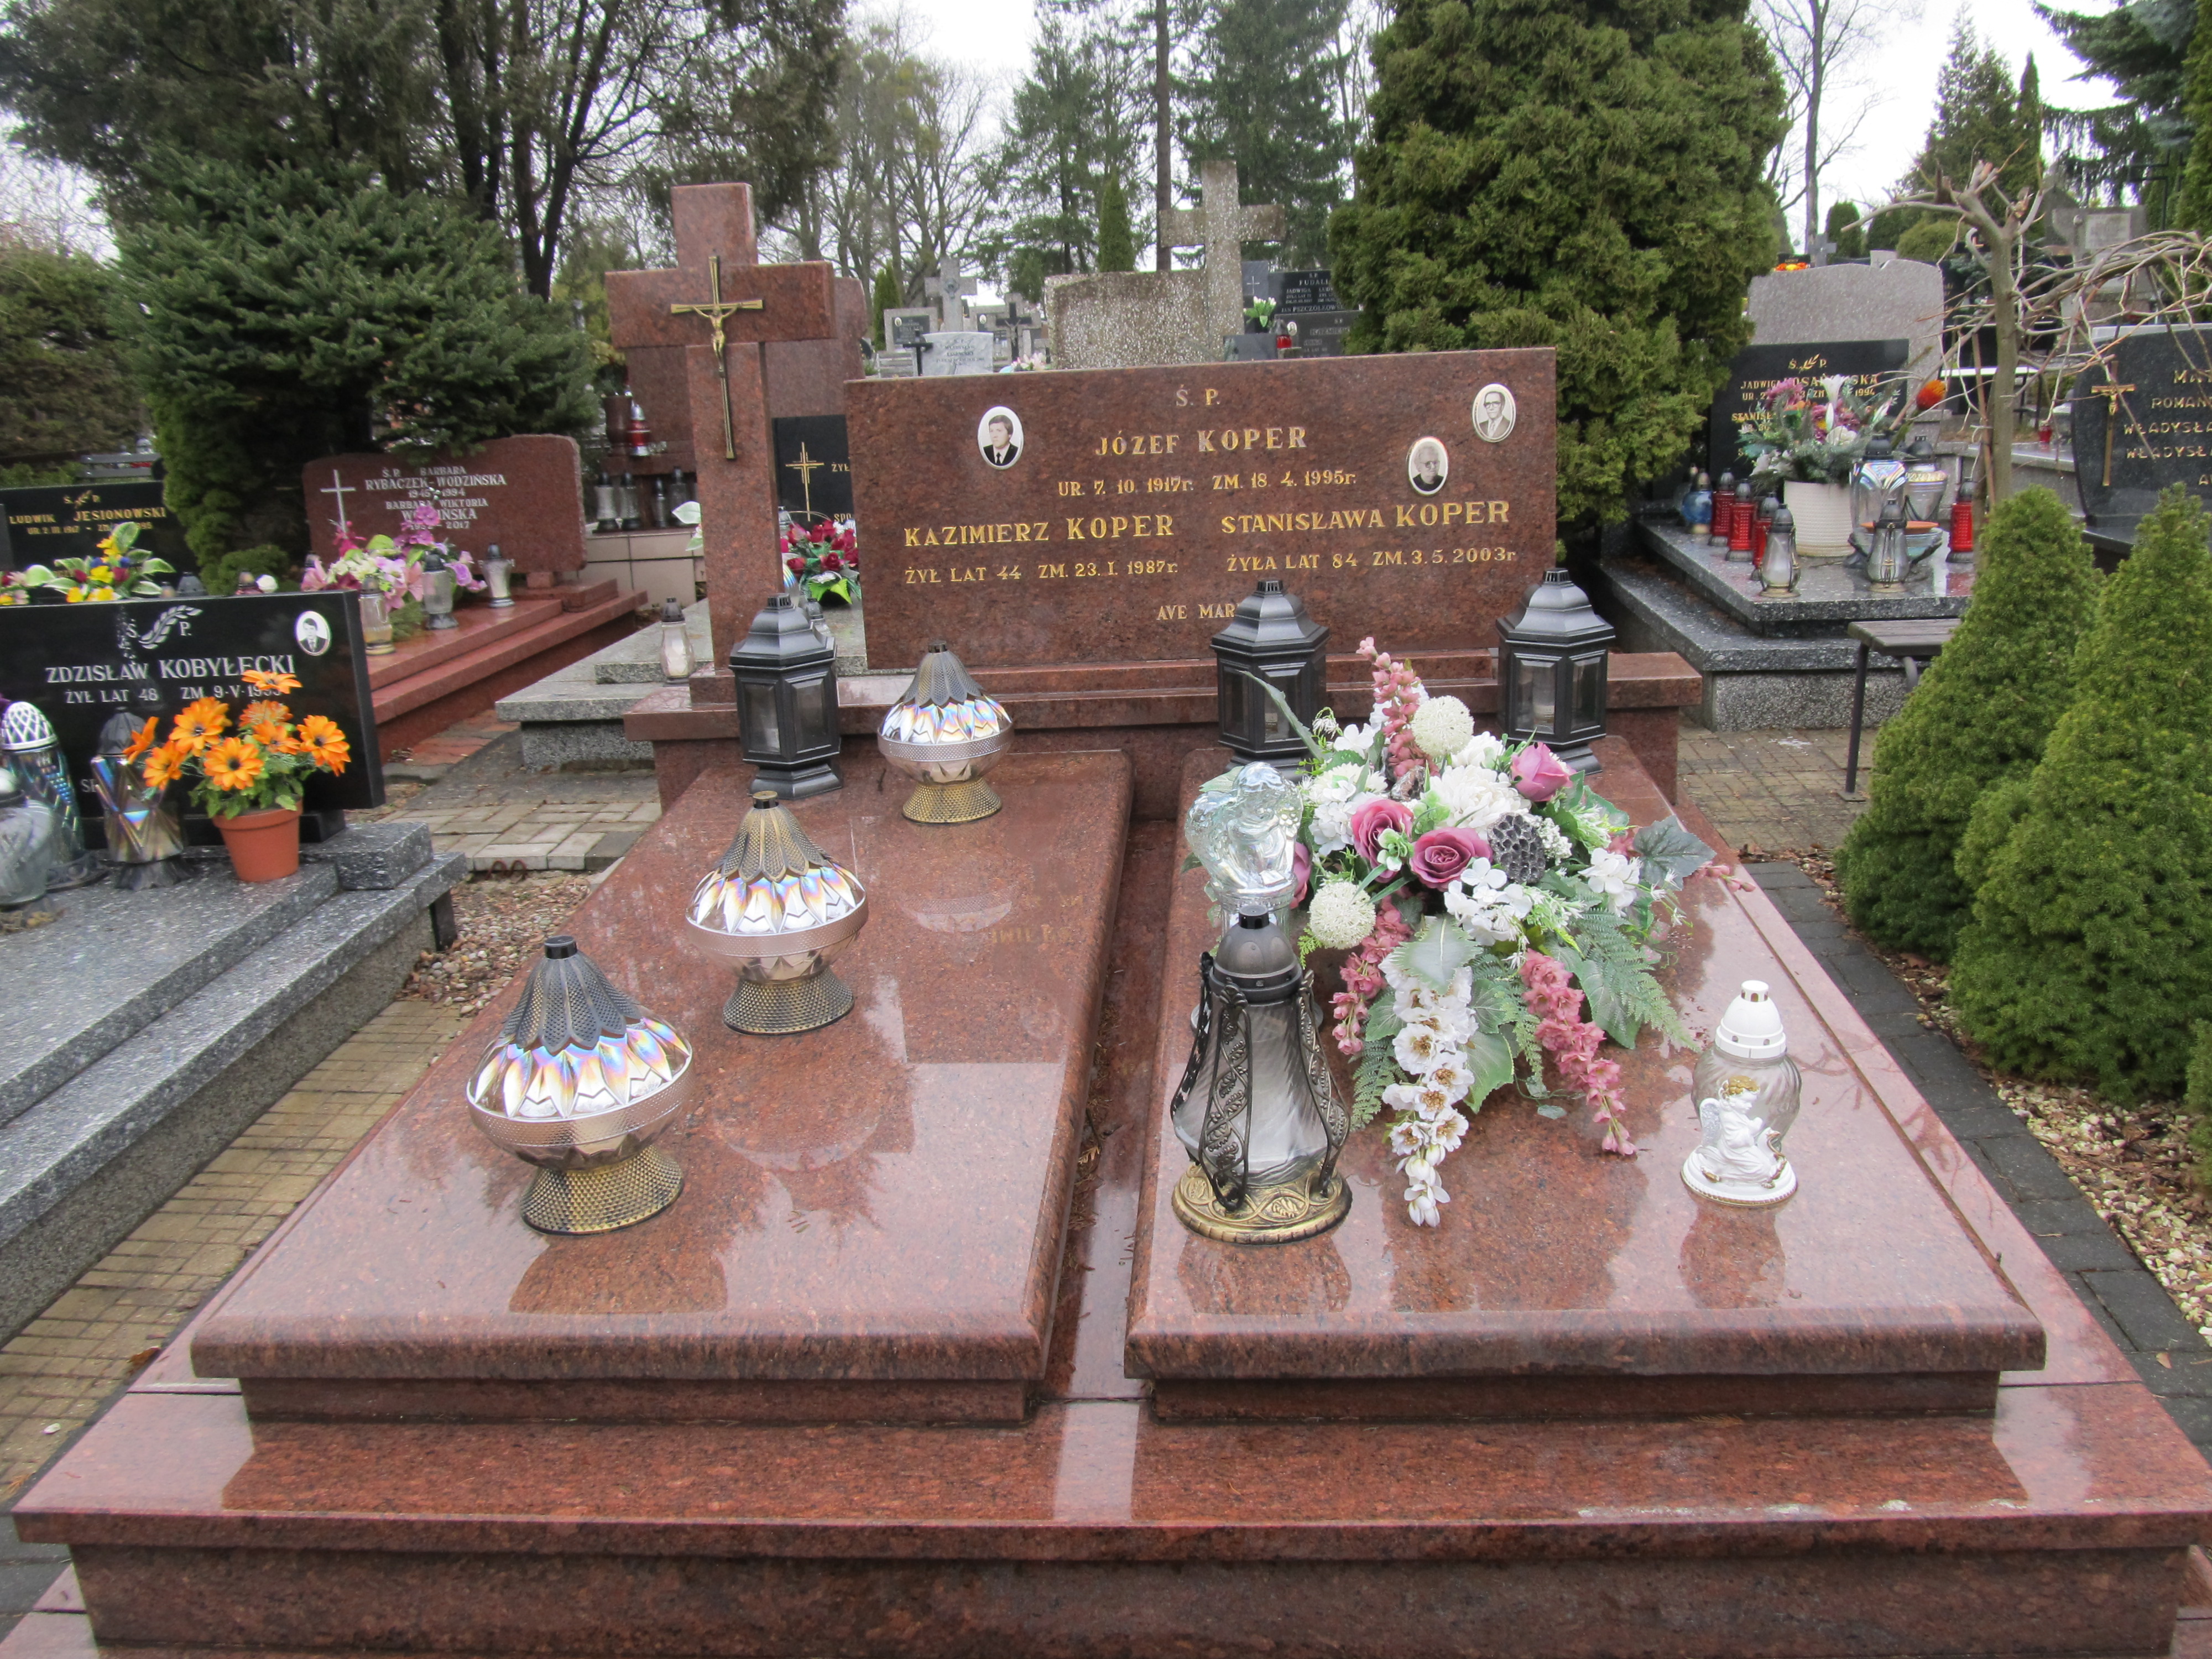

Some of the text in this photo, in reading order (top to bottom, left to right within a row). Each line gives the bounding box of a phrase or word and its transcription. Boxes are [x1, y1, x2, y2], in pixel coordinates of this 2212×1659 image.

[1205, 388, 1220, 405] P.
[1855, 388, 1875, 397] 1994
[1095, 426, 1307, 456] JÓZEF KOPER
[420, 466, 466, 476] BARBARA
[1058, 480, 1085, 497] UR.
[1212, 474, 1243, 491] ZM.
[439, 498, 488, 508] WIKTORIA
[9, 507, 166, 524] LUDWIK JESIONOWSKI
[1220, 500, 1510, 534] STANISŁAWA KOPER
[904, 514, 1175, 547] KAZIMIERZ KOPER
[1227, 554, 1277, 572] ŻYŁA
[1285, 554, 1320, 570] LAT
[1332, 553, 1357, 568] 84
[905, 566, 941, 584] ŻYŁ
[950, 567, 987, 582] LAT
[996, 565, 1022, 580] 44
[1037, 564, 1068, 579] ZM.
[1126, 560, 1178, 575] 1987r.
[1156, 605, 1187, 620] AVE
[180, 622, 192, 636] P.
[45, 663, 148, 683] ZDZISŁAW
[64, 689, 94, 703] ŻYŁ
[100, 689, 129, 702] LAT
[138, 688, 159, 701] 48
